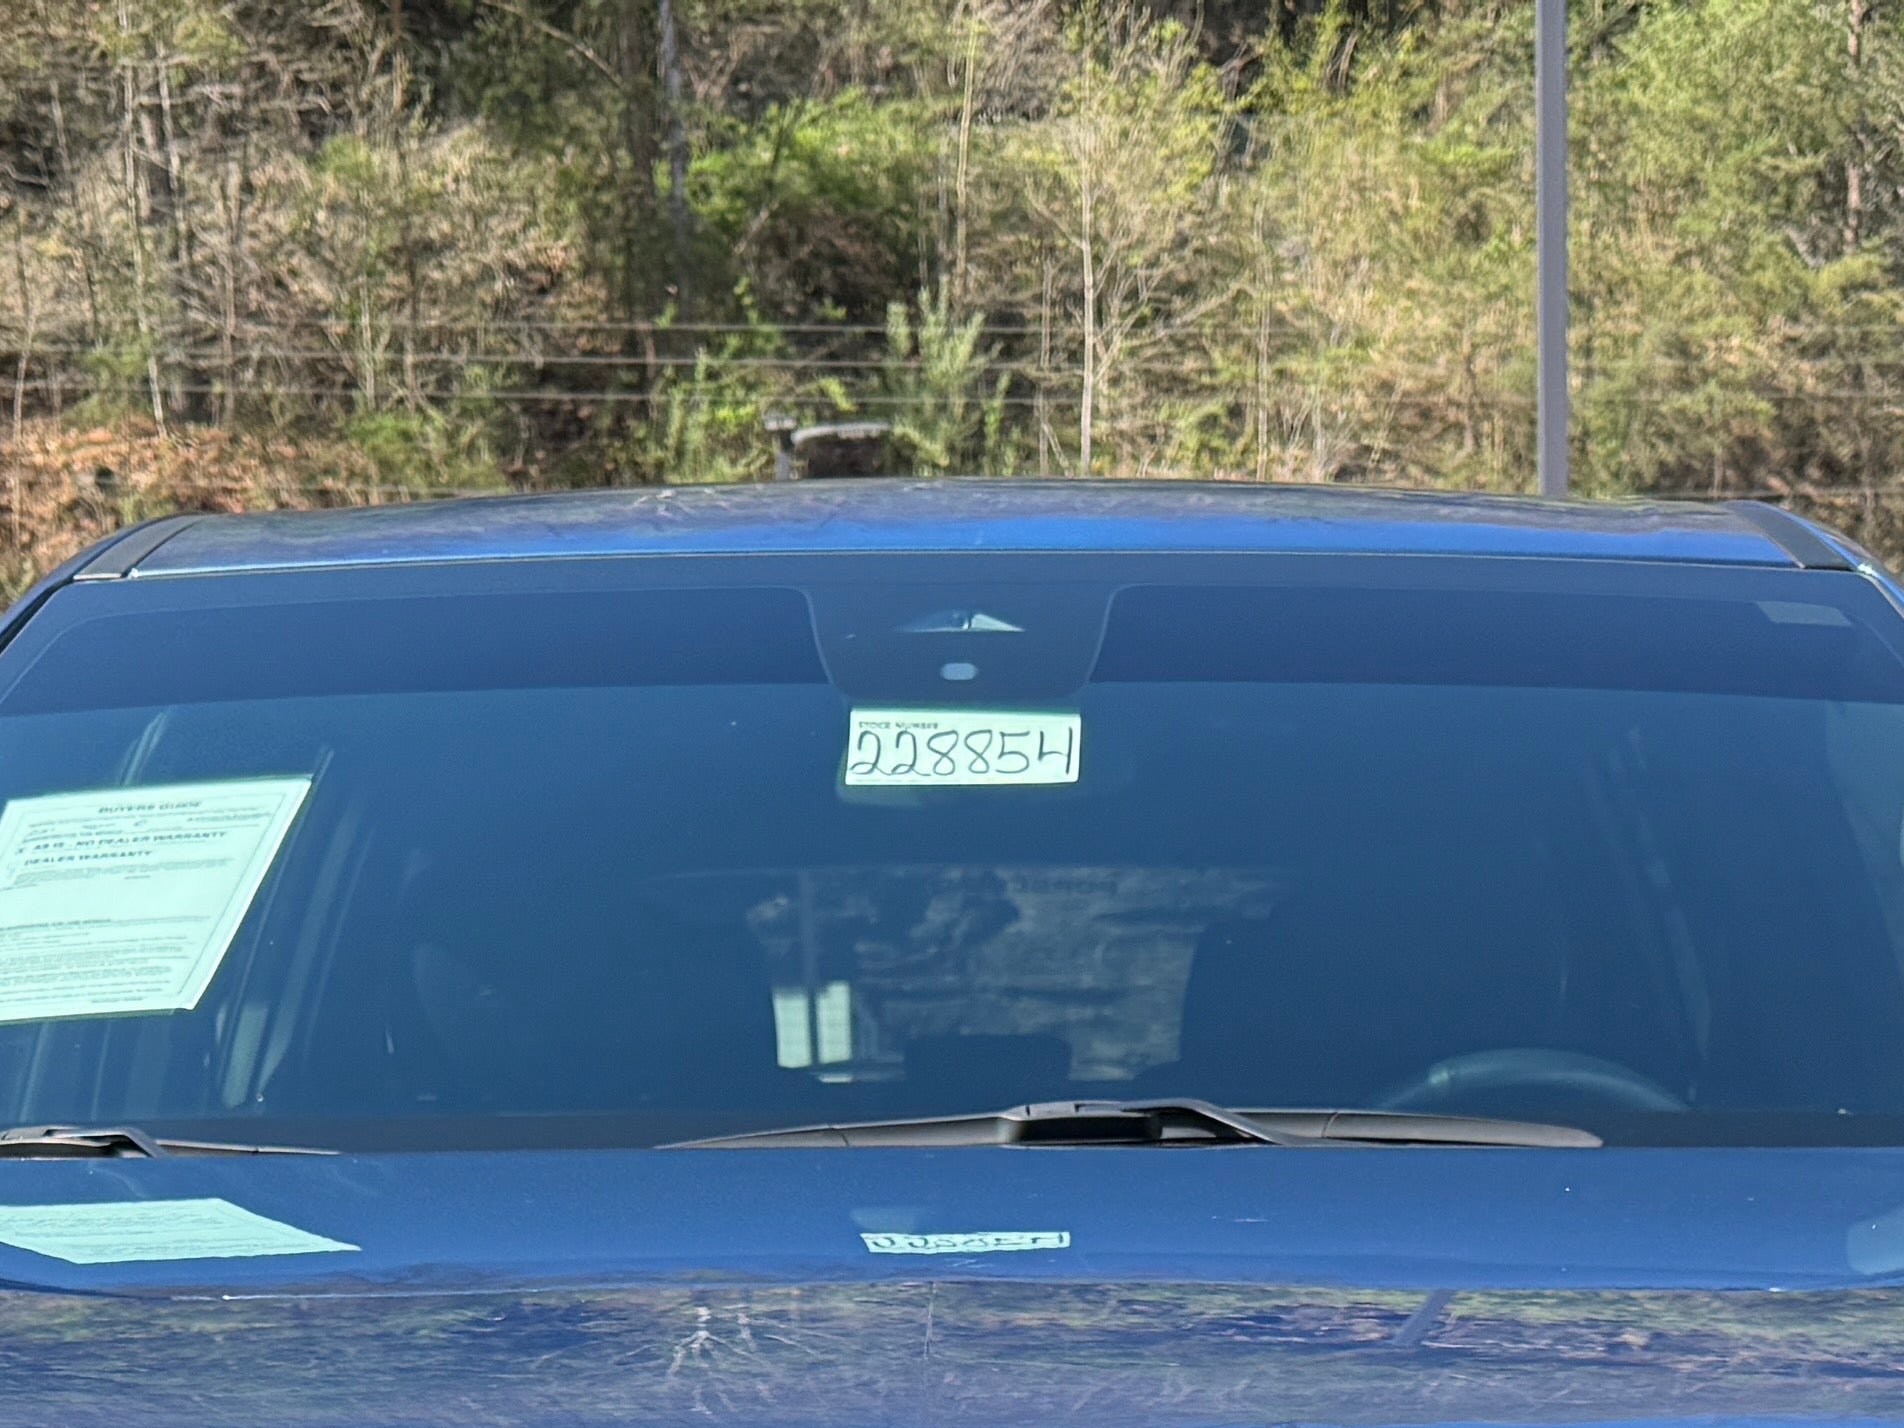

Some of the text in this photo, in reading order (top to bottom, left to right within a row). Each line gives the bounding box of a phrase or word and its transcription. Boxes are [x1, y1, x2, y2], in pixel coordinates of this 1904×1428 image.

[849, 726, 1073, 777] 228854
[98, 836, 151, 846] DEALER
[153, 831, 228, 842] WARRANTY
[23, 850, 153, 866] DEALER WARRANTY
